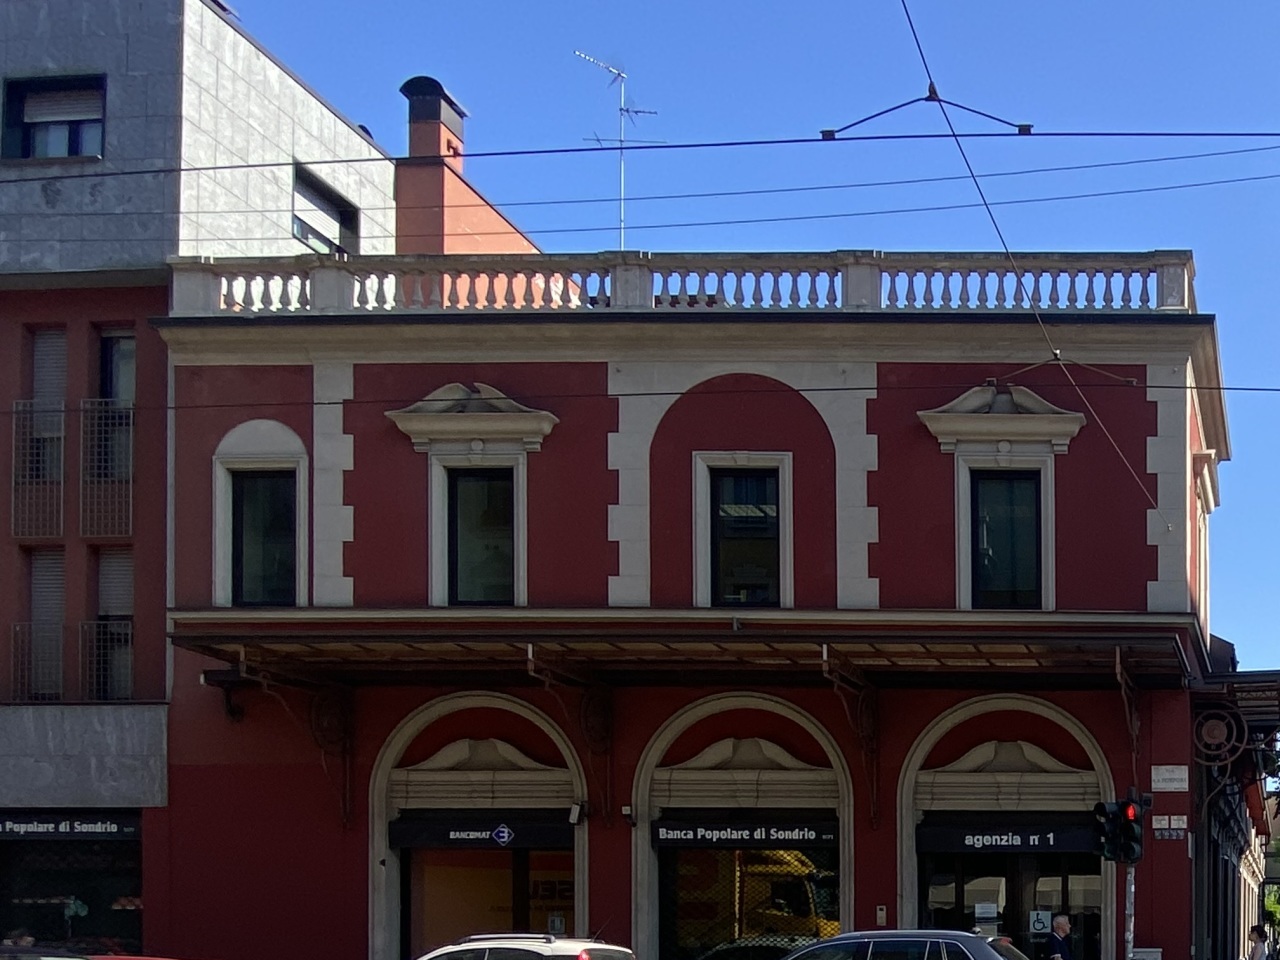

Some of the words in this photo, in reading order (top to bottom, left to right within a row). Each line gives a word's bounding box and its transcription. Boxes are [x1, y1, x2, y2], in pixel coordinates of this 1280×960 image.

[5, 821, 55, 835] Popolare
[59, 821, 70, 833] di
[74, 821, 118, 833] Sondrio
[449, 831, 491, 839] BANCOMAT
[658, 828, 694, 839] Banca
[697, 828, 750, 842] Popolare
[753, 828, 766, 839] di
[769, 828, 816, 839] Sondrio
[964, 832, 1021, 848] agenzia
[1046, 832, 1054, 846] 1
